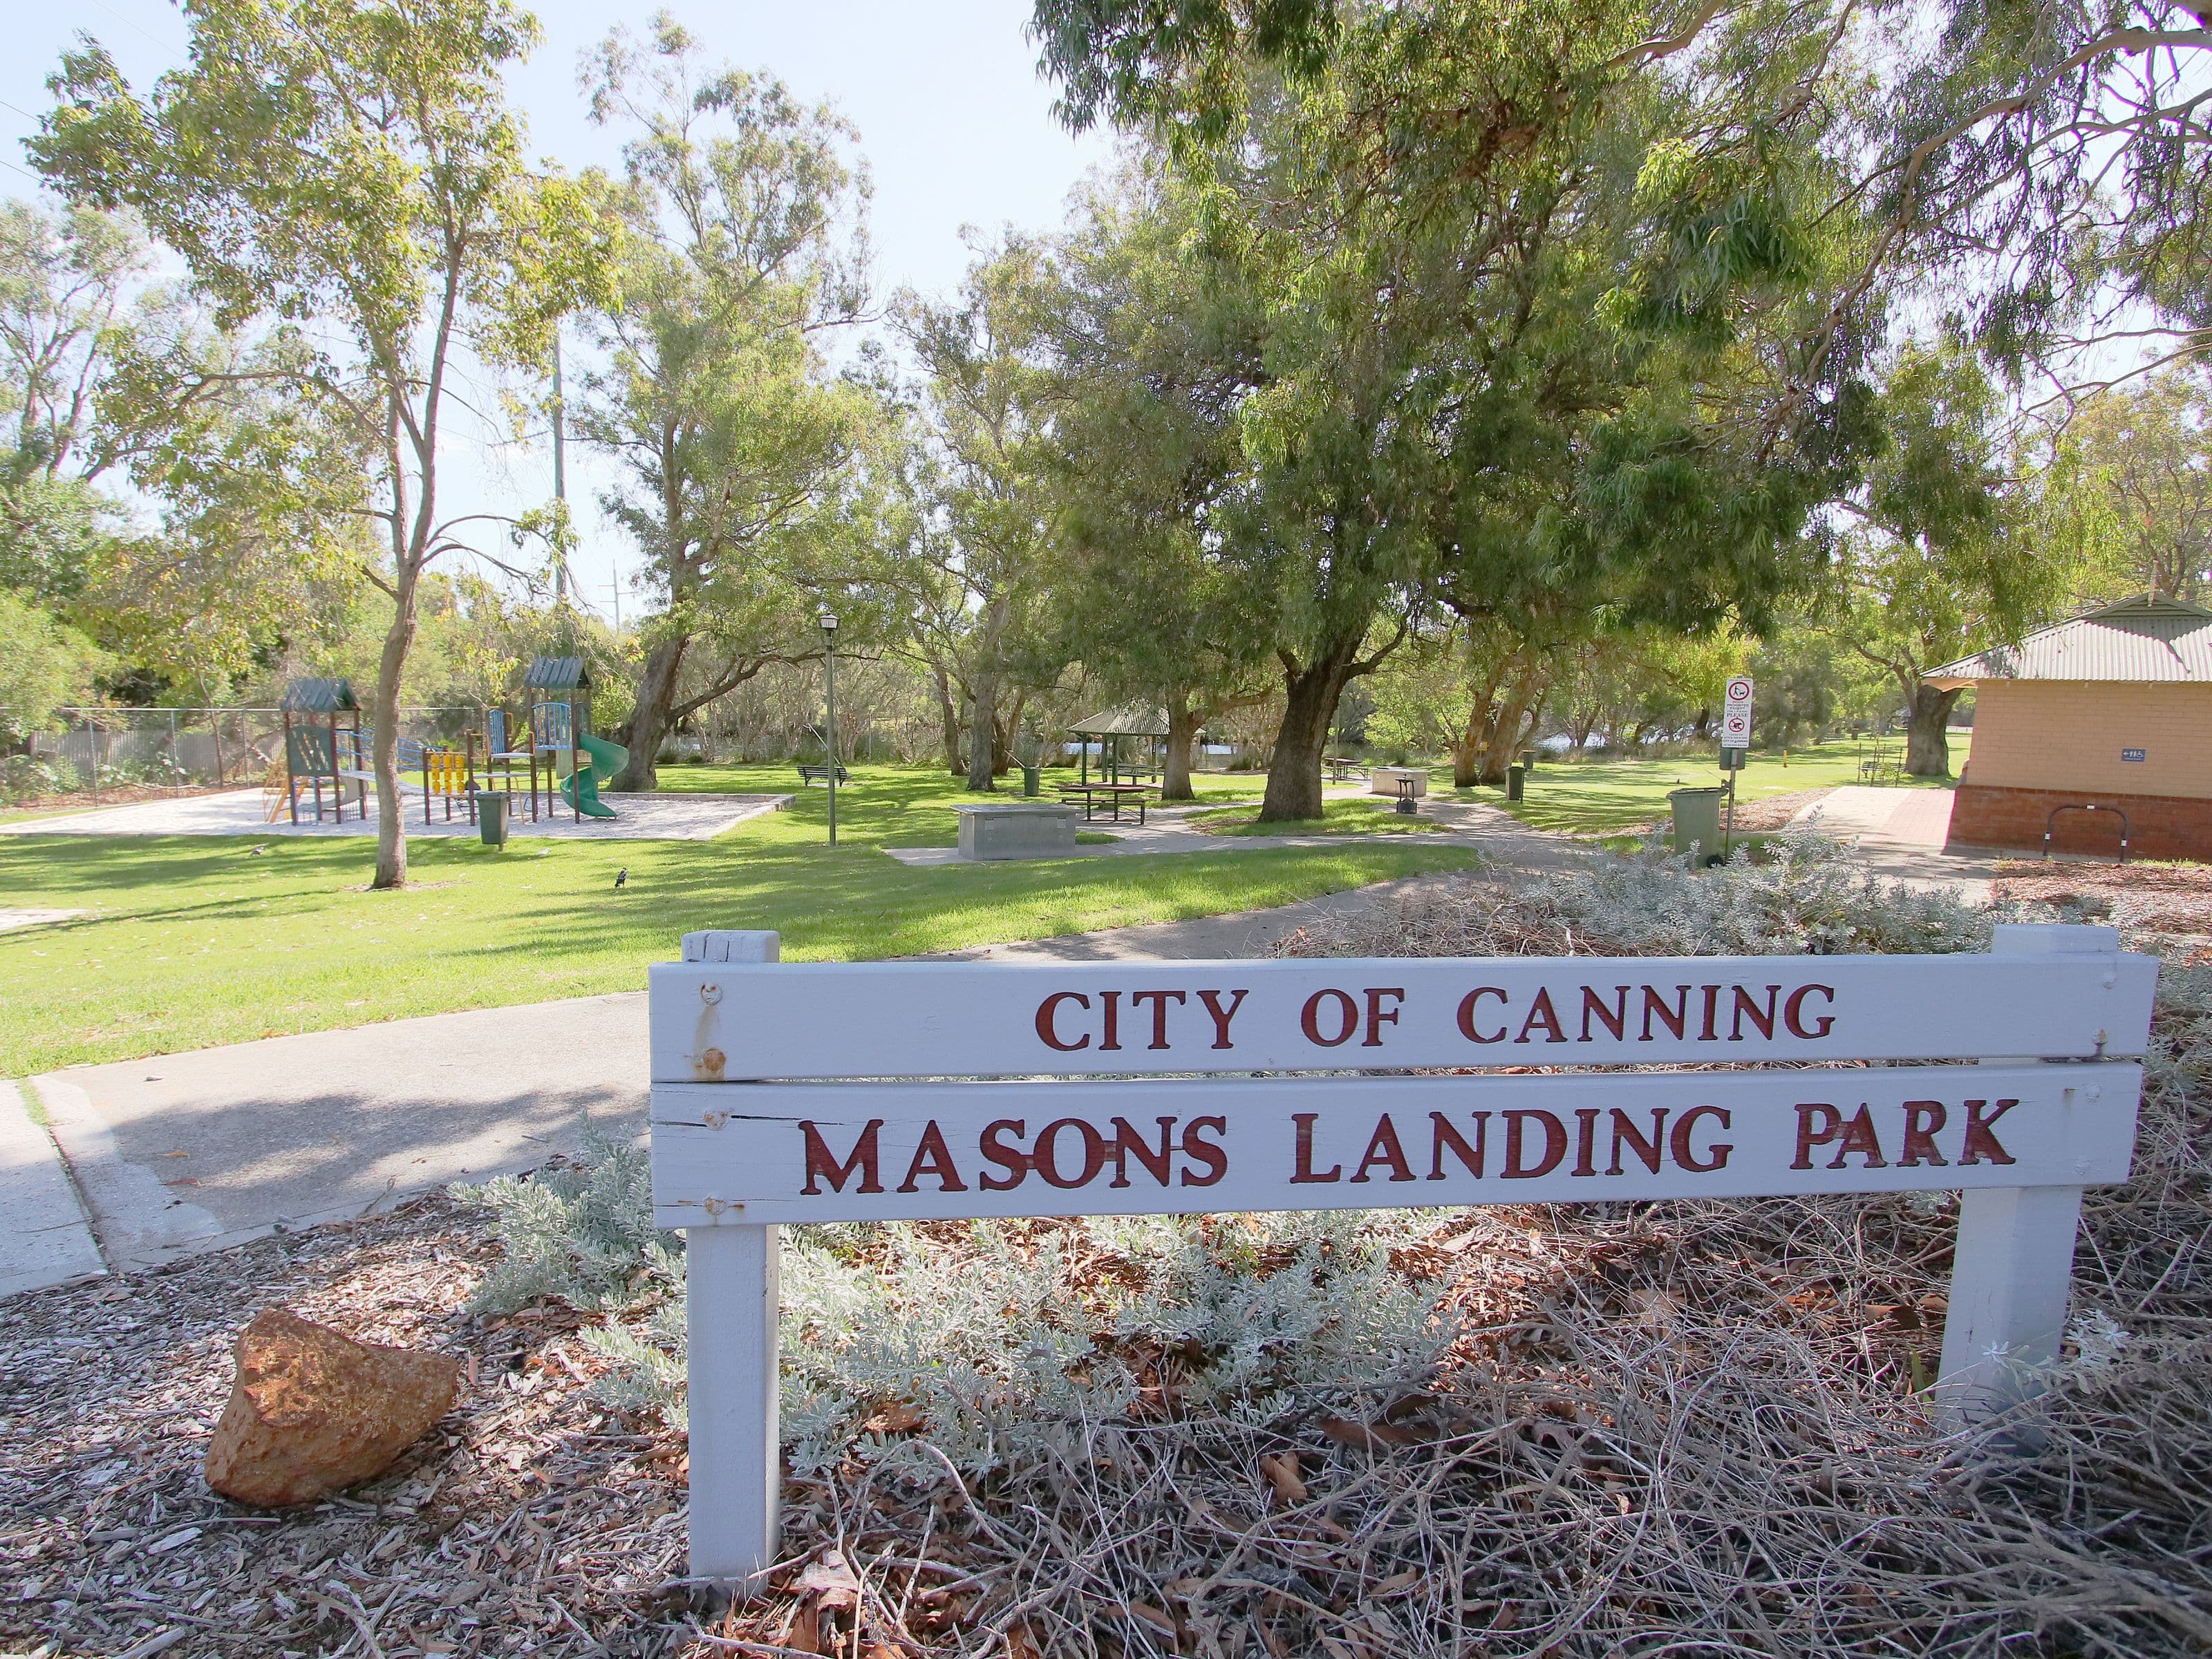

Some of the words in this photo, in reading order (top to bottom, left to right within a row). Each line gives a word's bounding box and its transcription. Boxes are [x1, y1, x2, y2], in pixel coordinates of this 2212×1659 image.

[1035, 989, 1250, 1051] CITY
[1300, 987, 1405, 1047] OF
[1456, 983, 1836, 1043] CANNING
[798, 1115, 1228, 1195] MASONS
[1289, 1105, 1733, 1184] LANDING
[1789, 1098, 2020, 1170] PARK
